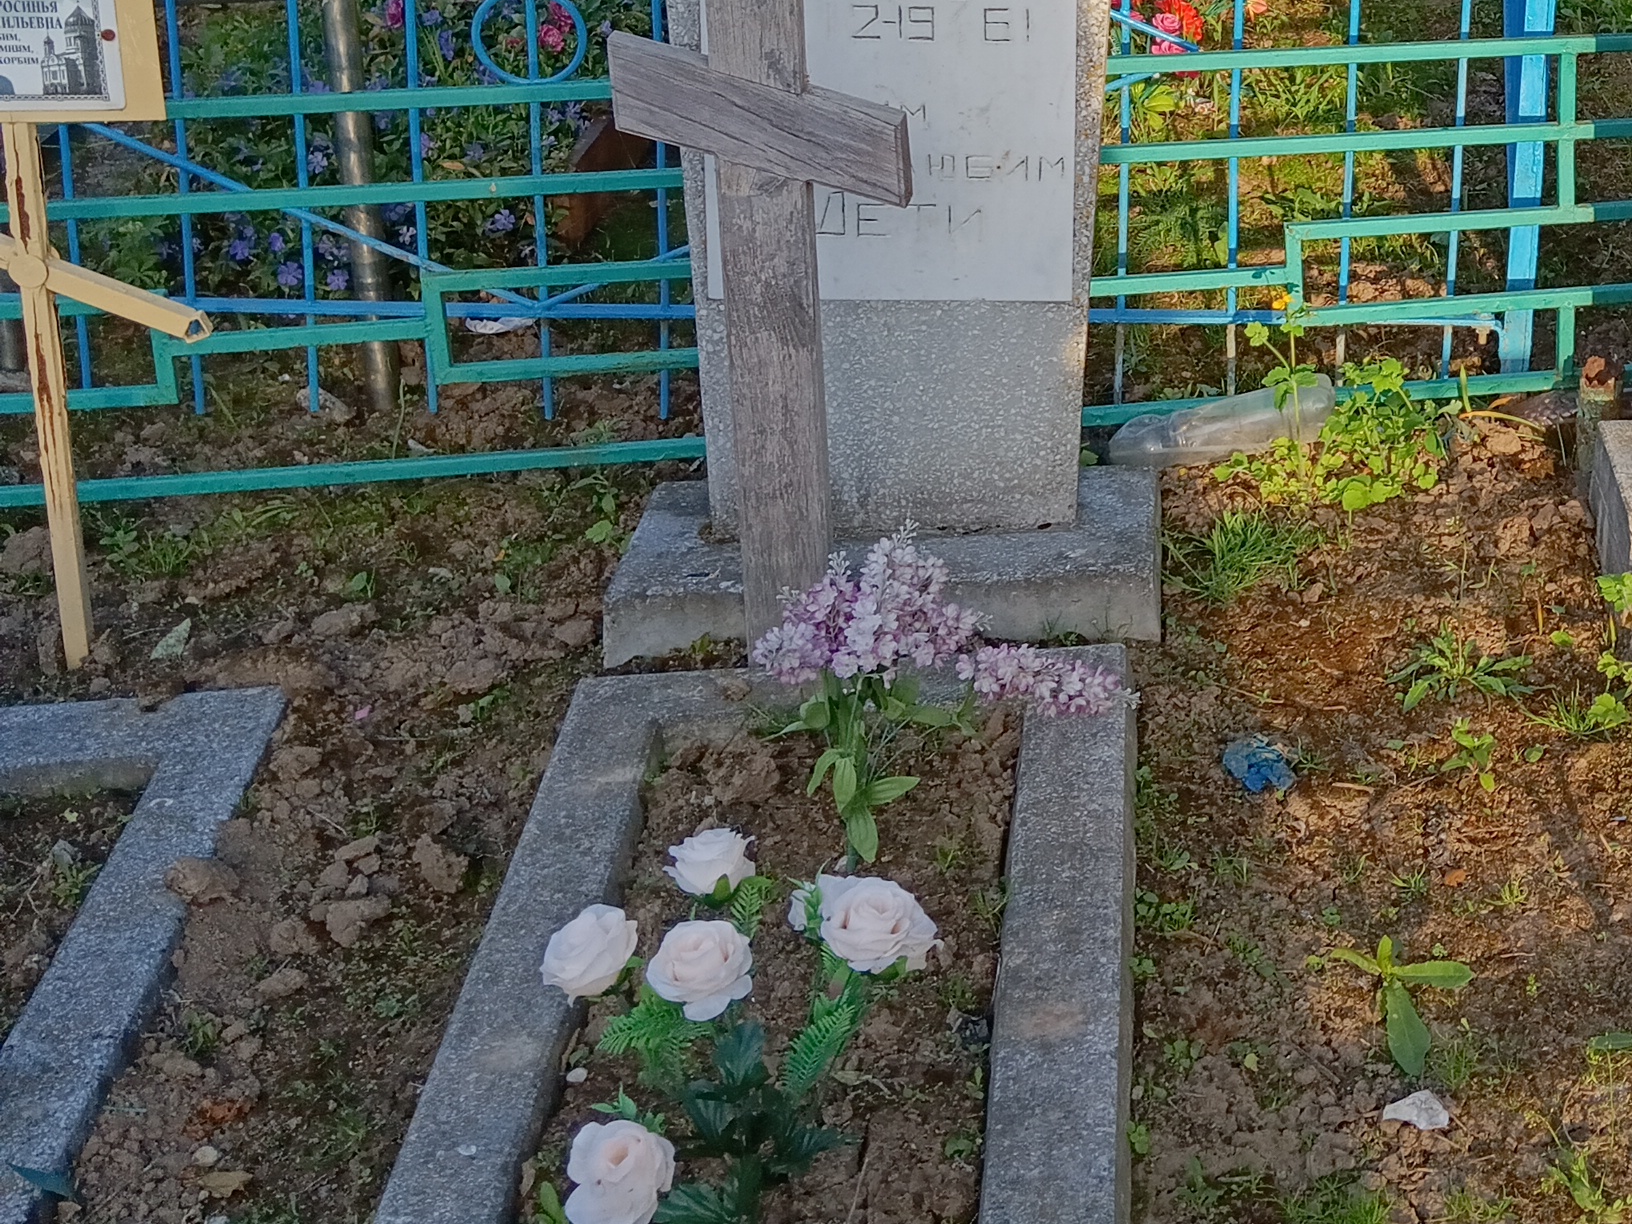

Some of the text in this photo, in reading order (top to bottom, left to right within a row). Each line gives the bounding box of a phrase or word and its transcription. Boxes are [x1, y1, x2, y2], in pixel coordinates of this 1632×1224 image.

[0, 0, 58, 14] ОСИНЬЯ
[1, 16, 63, 30] ИЛЬЕВНА
[926, 153, 1065, 181] ЮБИМ
[817, 190, 982, 238] ДЕТИ
